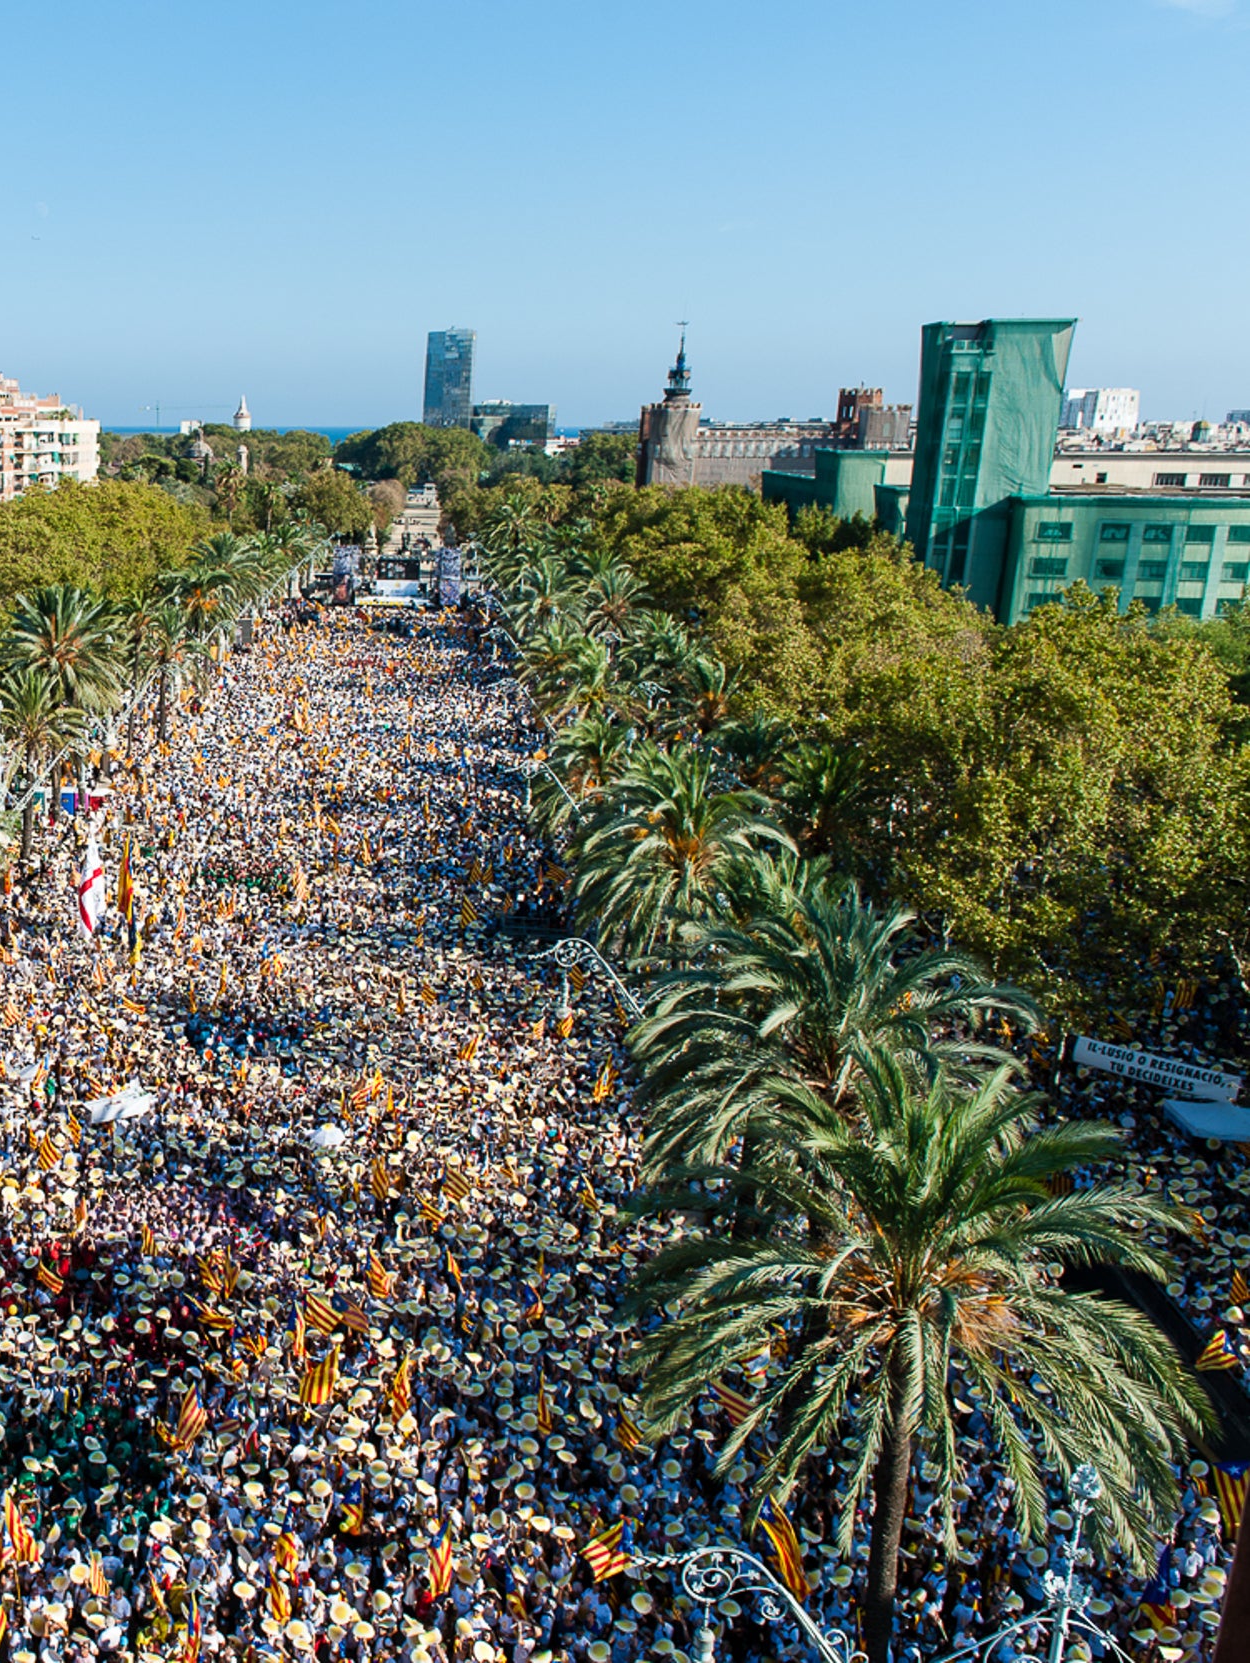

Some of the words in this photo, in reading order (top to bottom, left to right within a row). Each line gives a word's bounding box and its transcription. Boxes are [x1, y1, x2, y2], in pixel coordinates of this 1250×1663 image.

[1138, 1055, 1146, 1065] O
[1110, 1061, 1124, 1072] TU
[1128, 1066, 1195, 1090] DECIDEIXES
